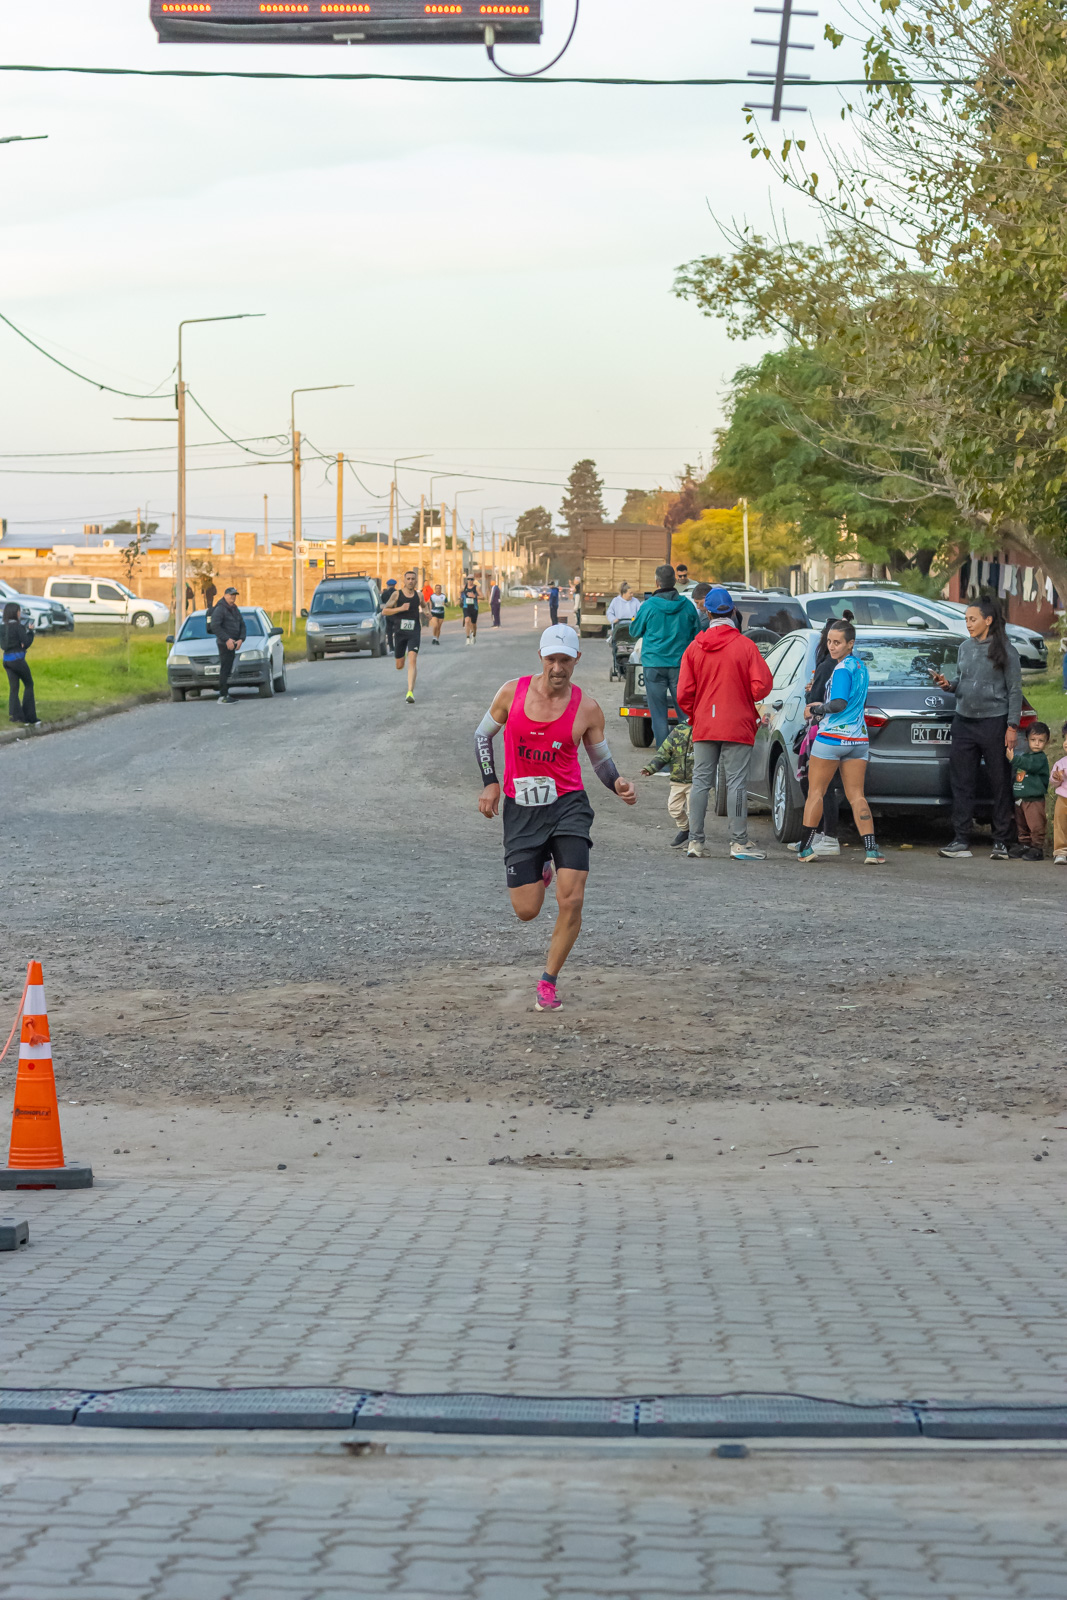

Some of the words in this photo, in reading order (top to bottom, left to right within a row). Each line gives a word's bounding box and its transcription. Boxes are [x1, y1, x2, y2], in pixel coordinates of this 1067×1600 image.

[913, 728, 931, 740] PKT
[477, 735, 493, 775] SPORTS
[521, 784, 551, 805] 117
